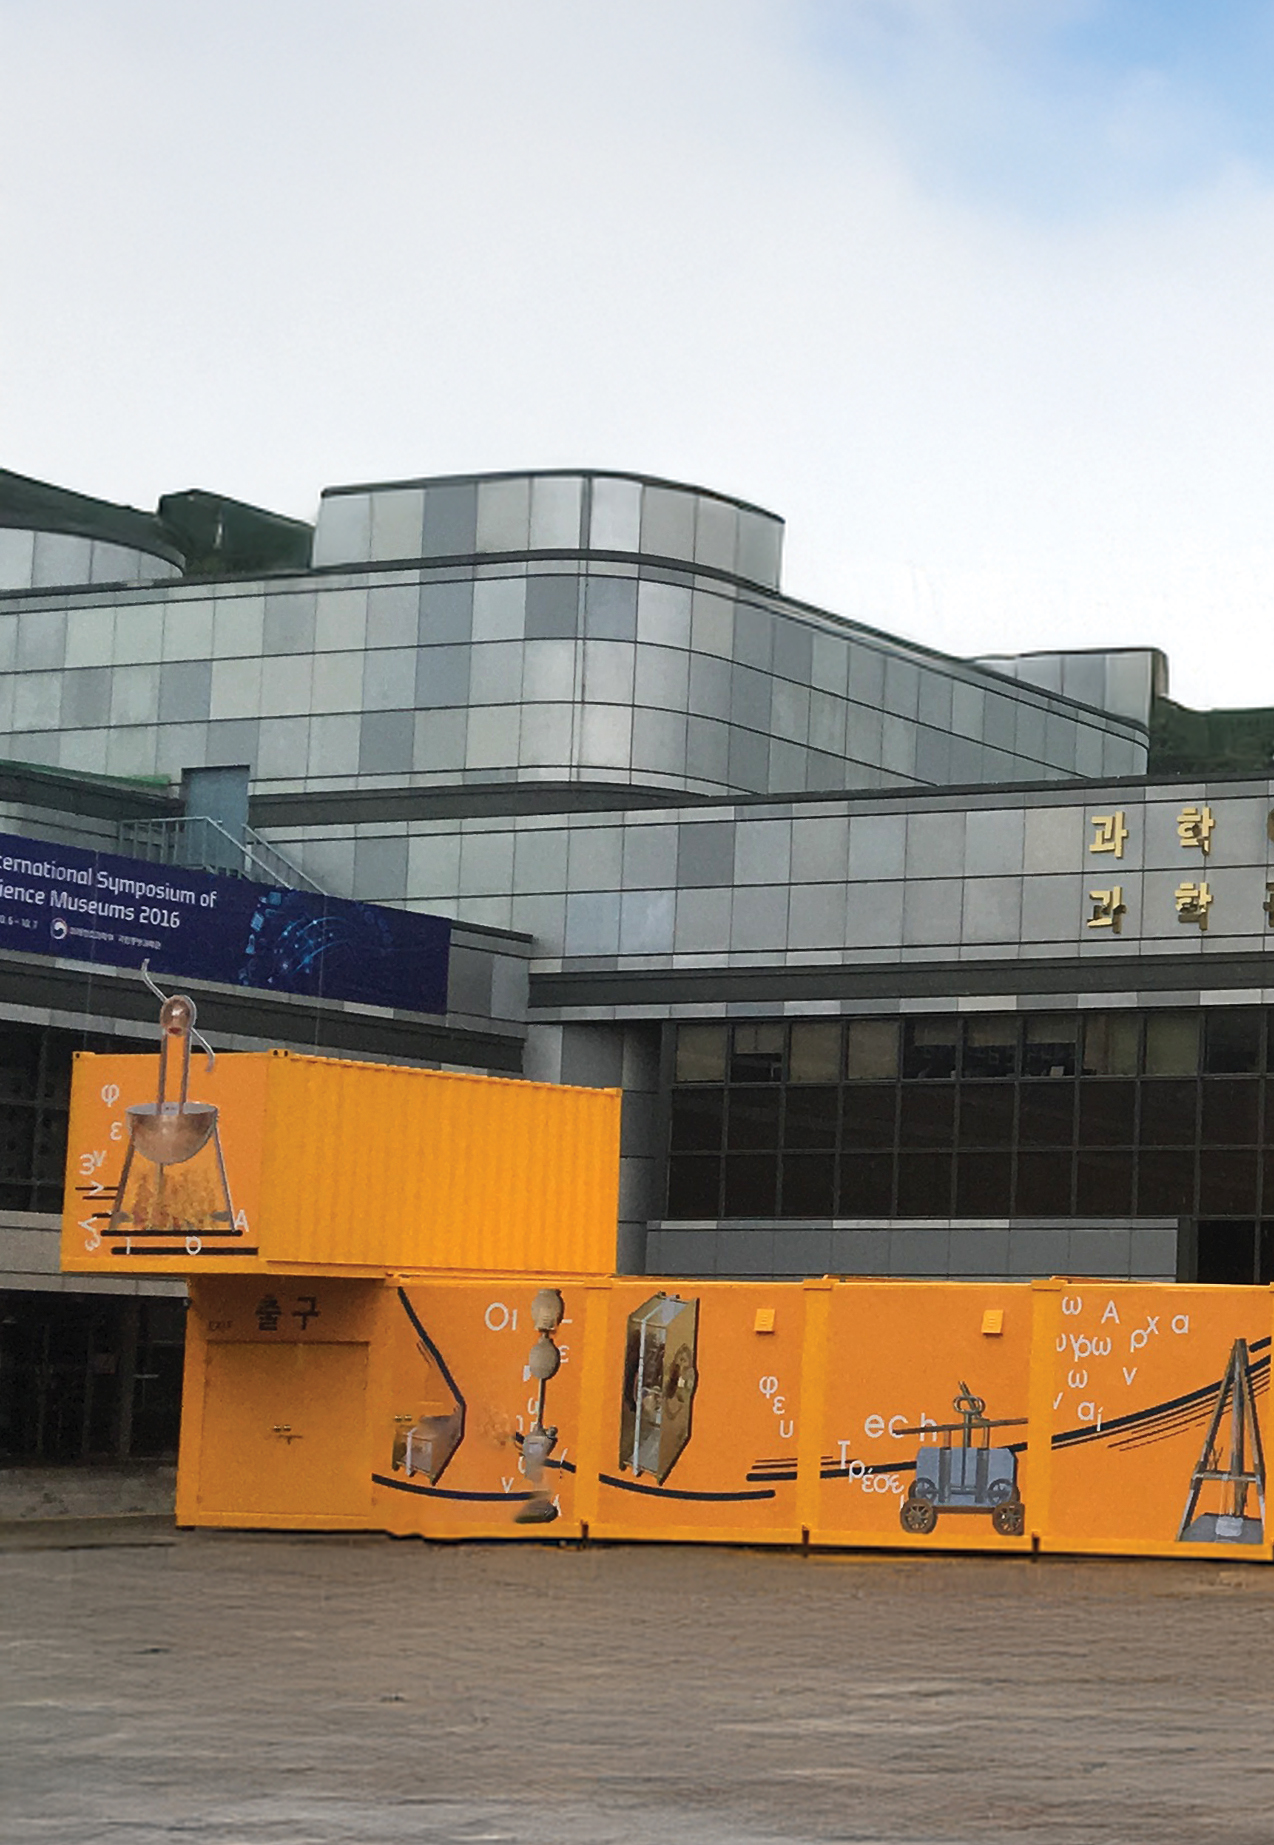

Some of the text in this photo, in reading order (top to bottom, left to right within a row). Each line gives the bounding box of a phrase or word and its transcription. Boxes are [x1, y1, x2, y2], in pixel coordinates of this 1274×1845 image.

[50, 889, 135, 921] Museums
[139, 906, 181, 928] 2016
[97, 871, 196, 904] Symposium
[200, 891, 218, 908] of
